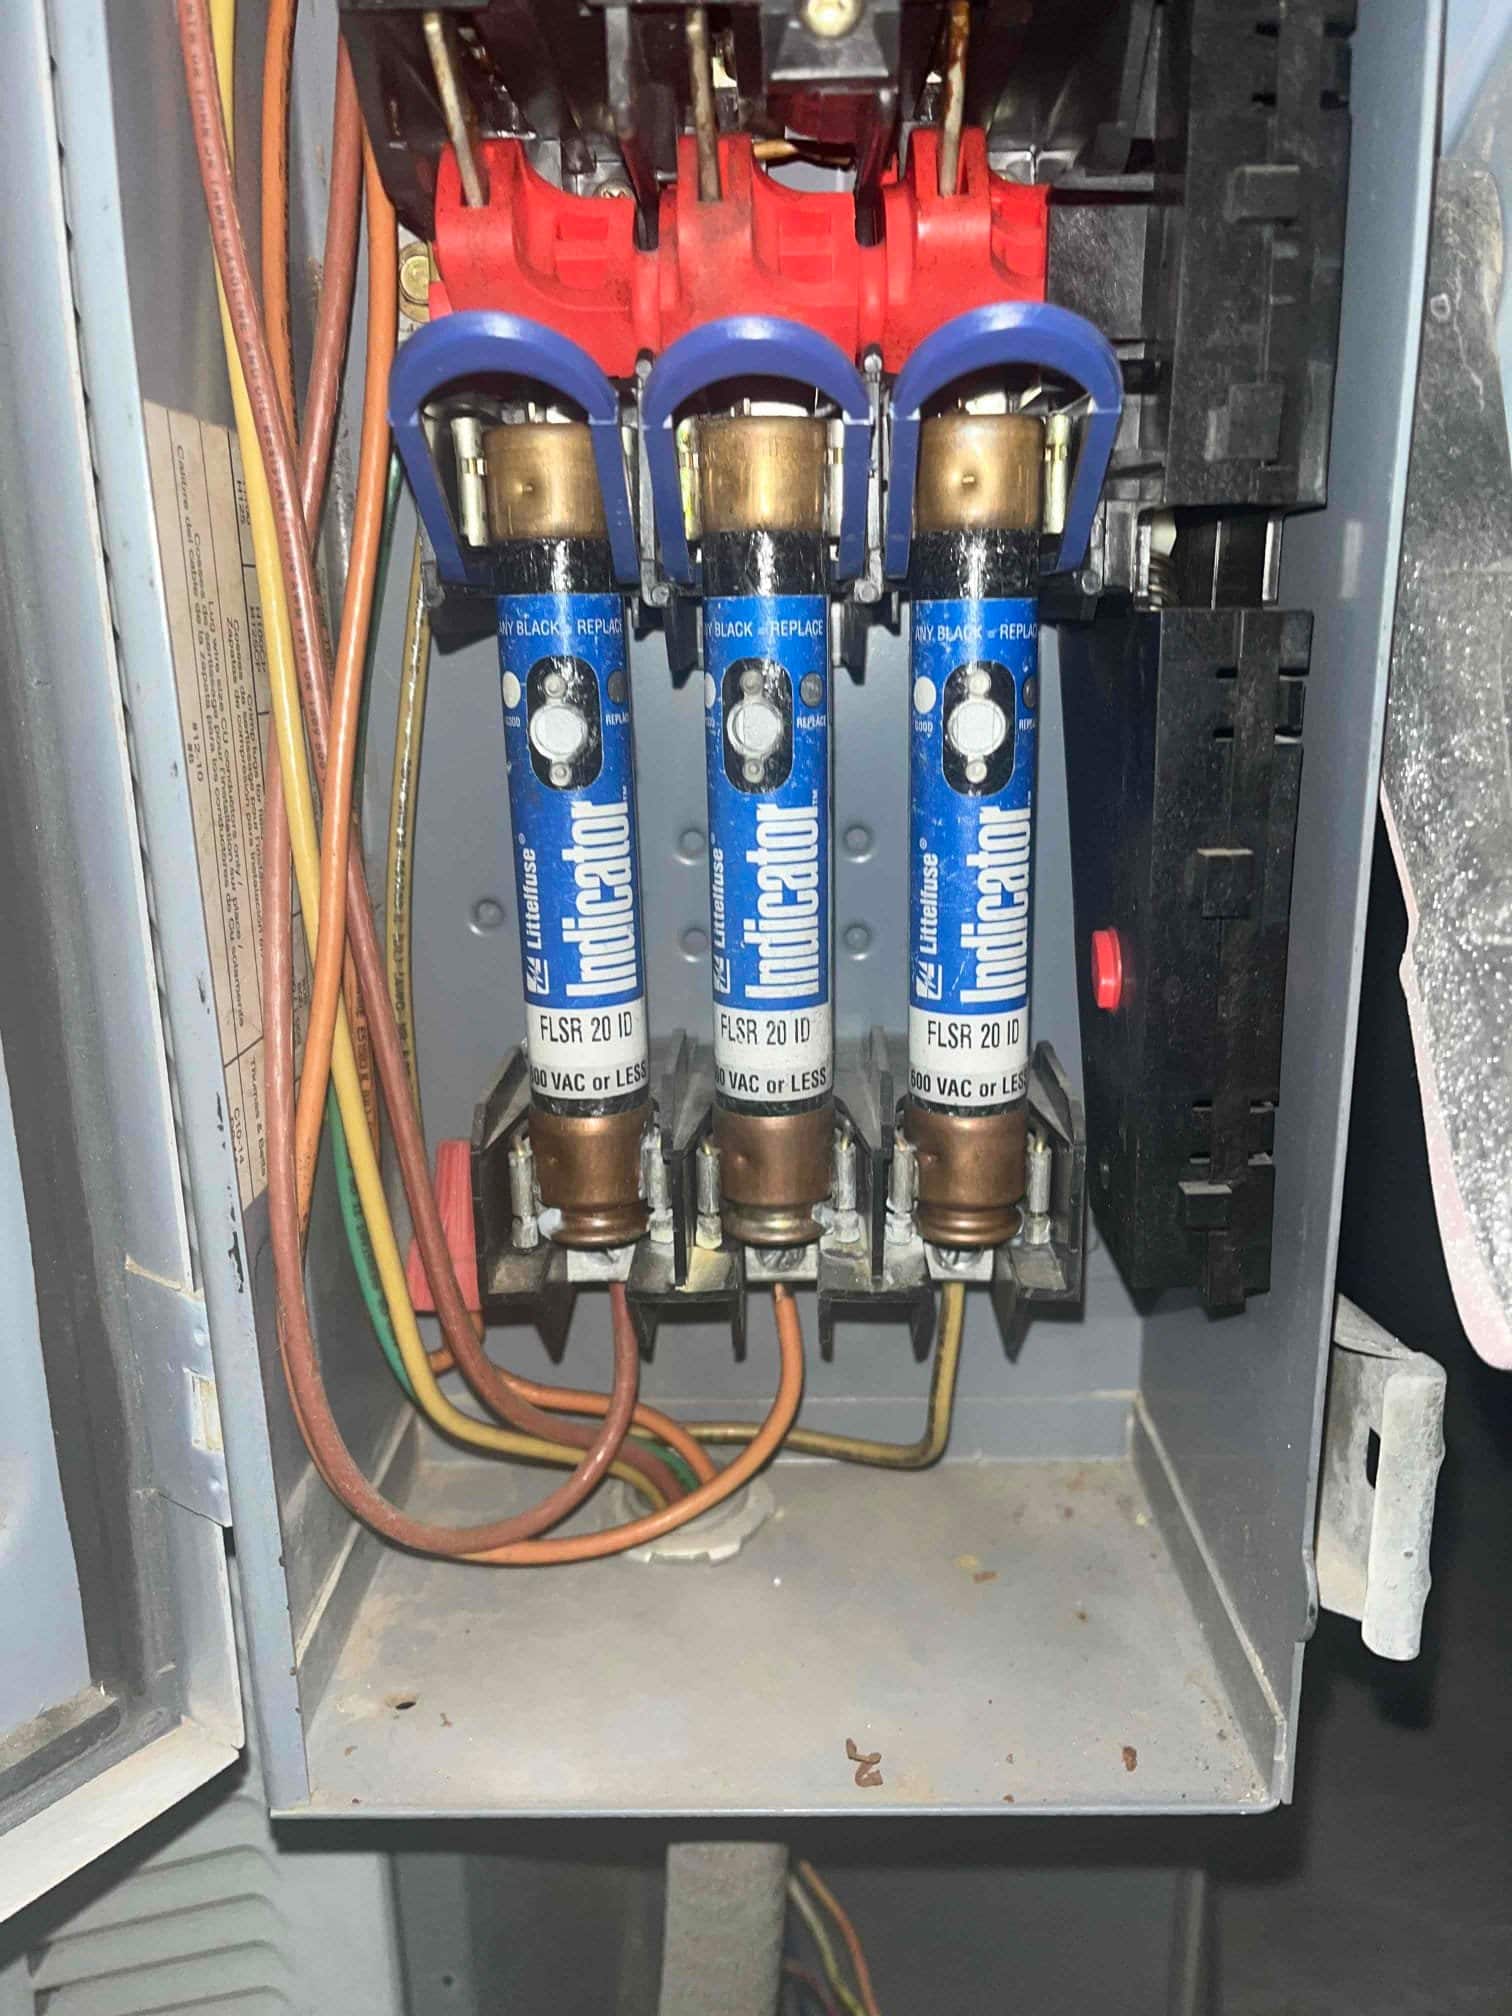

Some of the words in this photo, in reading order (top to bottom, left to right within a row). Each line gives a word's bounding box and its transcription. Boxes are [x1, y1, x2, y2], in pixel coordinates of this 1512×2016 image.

[516, 619, 560, 636] BLACK
[715, 620, 753, 637] BLACK
[770, 619, 824, 637] REPLACE
[914, 625, 934, 641] ANY
[937, 625, 983, 641] BLACK
[1000, 623, 1038, 640] REPLAC
[207, 601, 216, 632] Lug
[212, 638, 220, 673] wire
[224, 749, 237, 838] conductors
[561, 800, 637, 997] Indicator
[743, 803, 819, 998] Indicator
[960, 805, 1032, 1003] Indicator
[540, 1014, 583, 1043] FLSR
[591, 1015, 611, 1042] 20
[618, 1011, 632, 1038] ID
[721, 1013, 758, 1045] FLSR
[766, 1019, 787, 1045] 20
[794, 1017, 810, 1043] ID
[928, 1020, 972, 1049] FLSR
[981, 1022, 1000, 1048] 20
[1007, 1018, 1019, 1045] ID
[551, 1071, 586, 1092] VAC
[592, 1075, 611, 1091] or
[616, 1061, 647, 1087] LESS
[729, 1070, 760, 1093] VAC
[767, 1080, 784, 1094] or
[791, 1066, 827, 1092] LESS
[911, 1069, 931, 1092] 600
[937, 1077, 972, 1098] VAC
[979, 1082, 997, 1097] or
